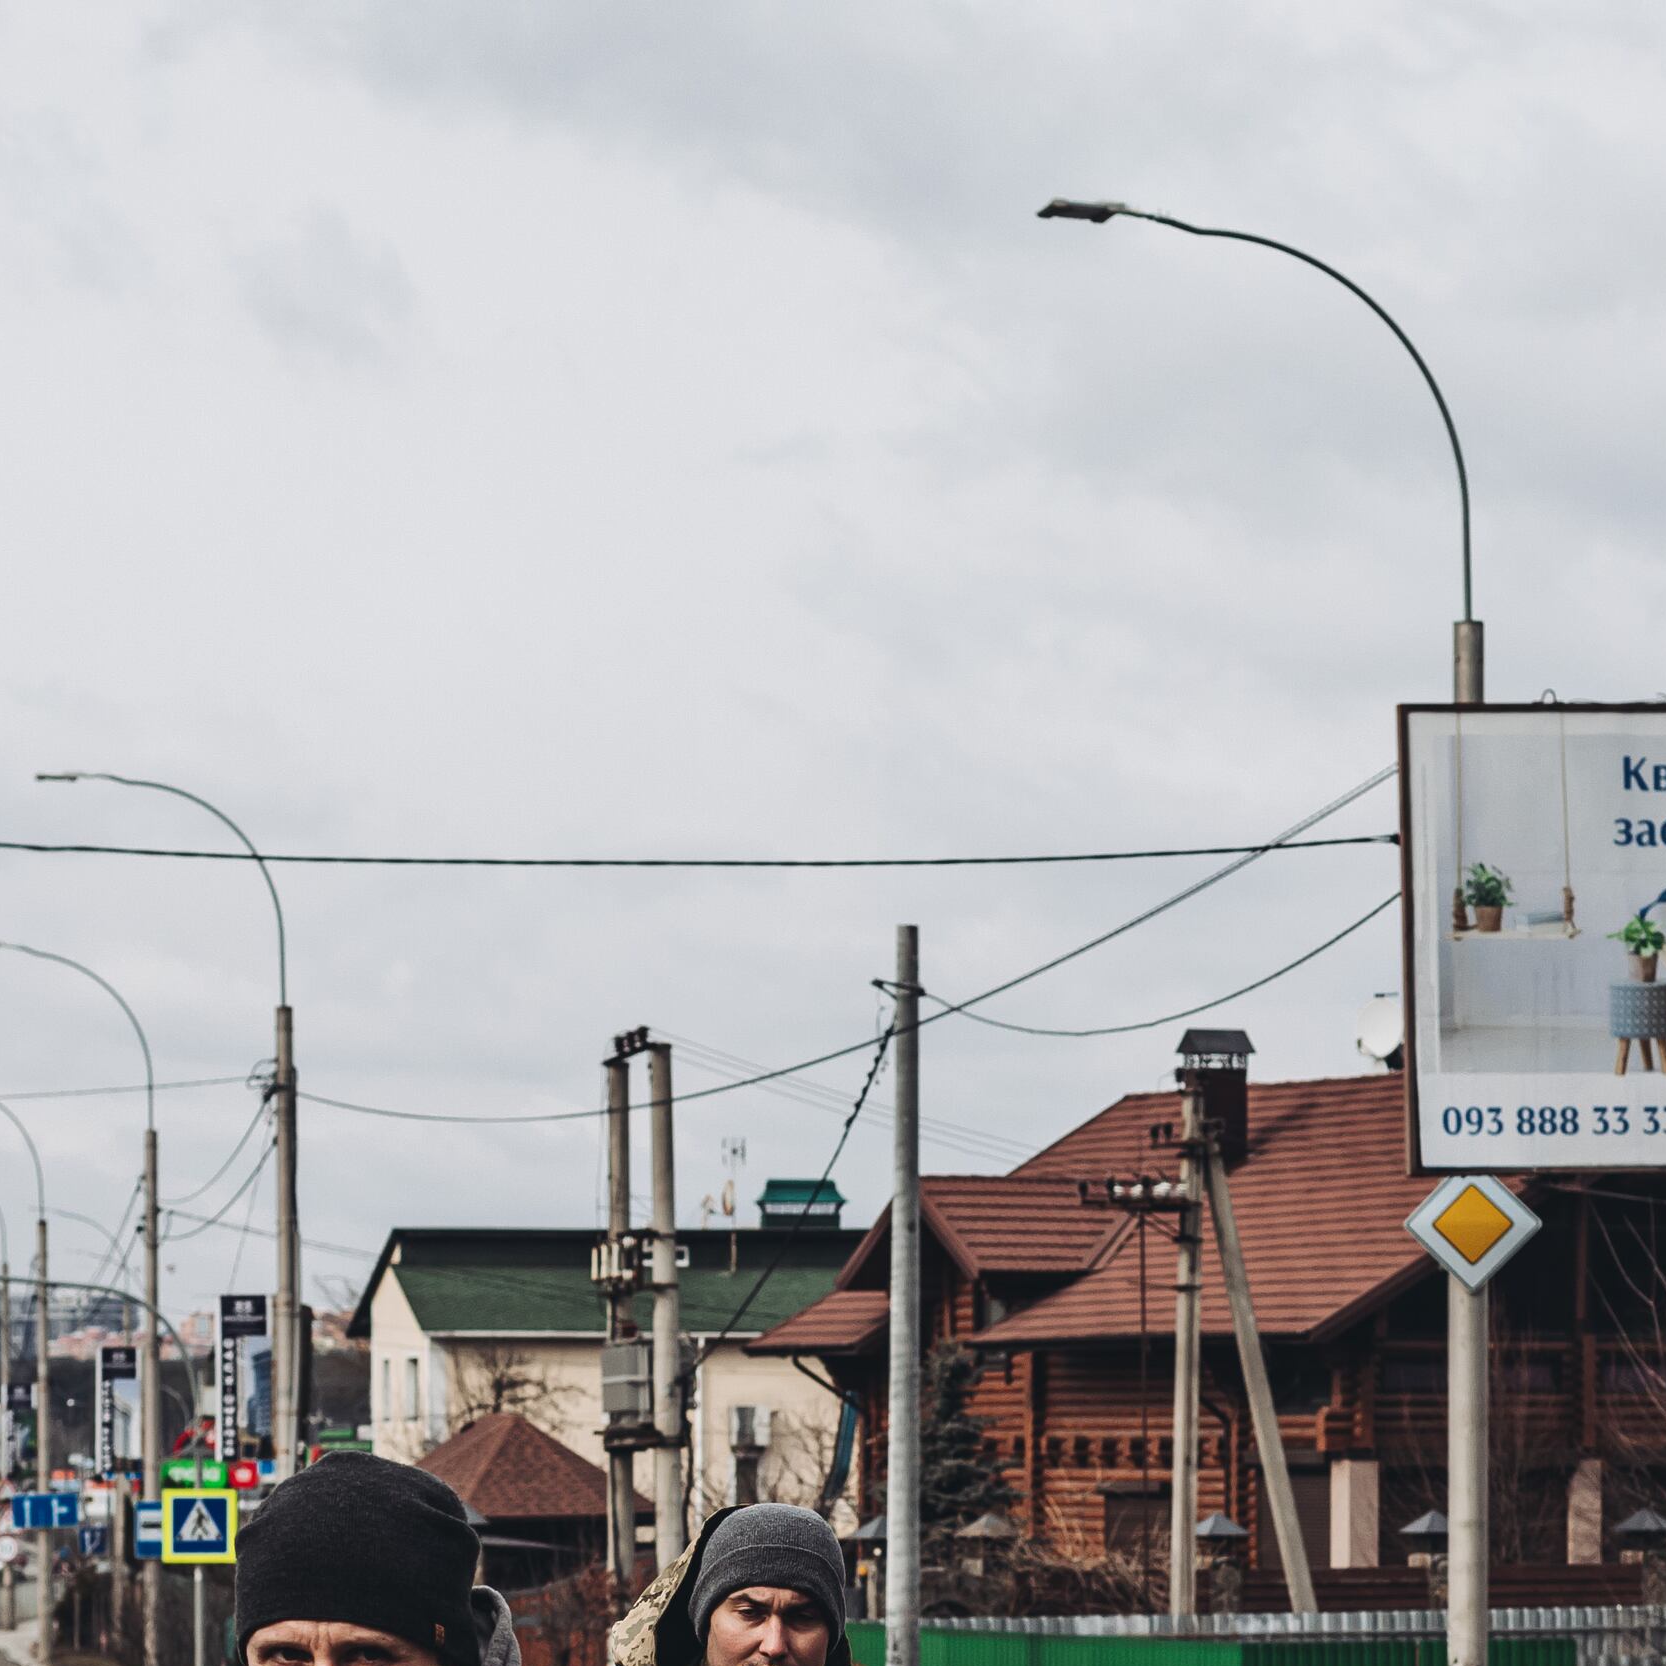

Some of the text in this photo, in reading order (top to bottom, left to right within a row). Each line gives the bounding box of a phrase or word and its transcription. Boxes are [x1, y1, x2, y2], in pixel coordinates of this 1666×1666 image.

[1442, 1106, 1504, 1135] 093
[1516, 1106, 1580, 1135] 888
[1592, 1106, 1630, 1135] 33
